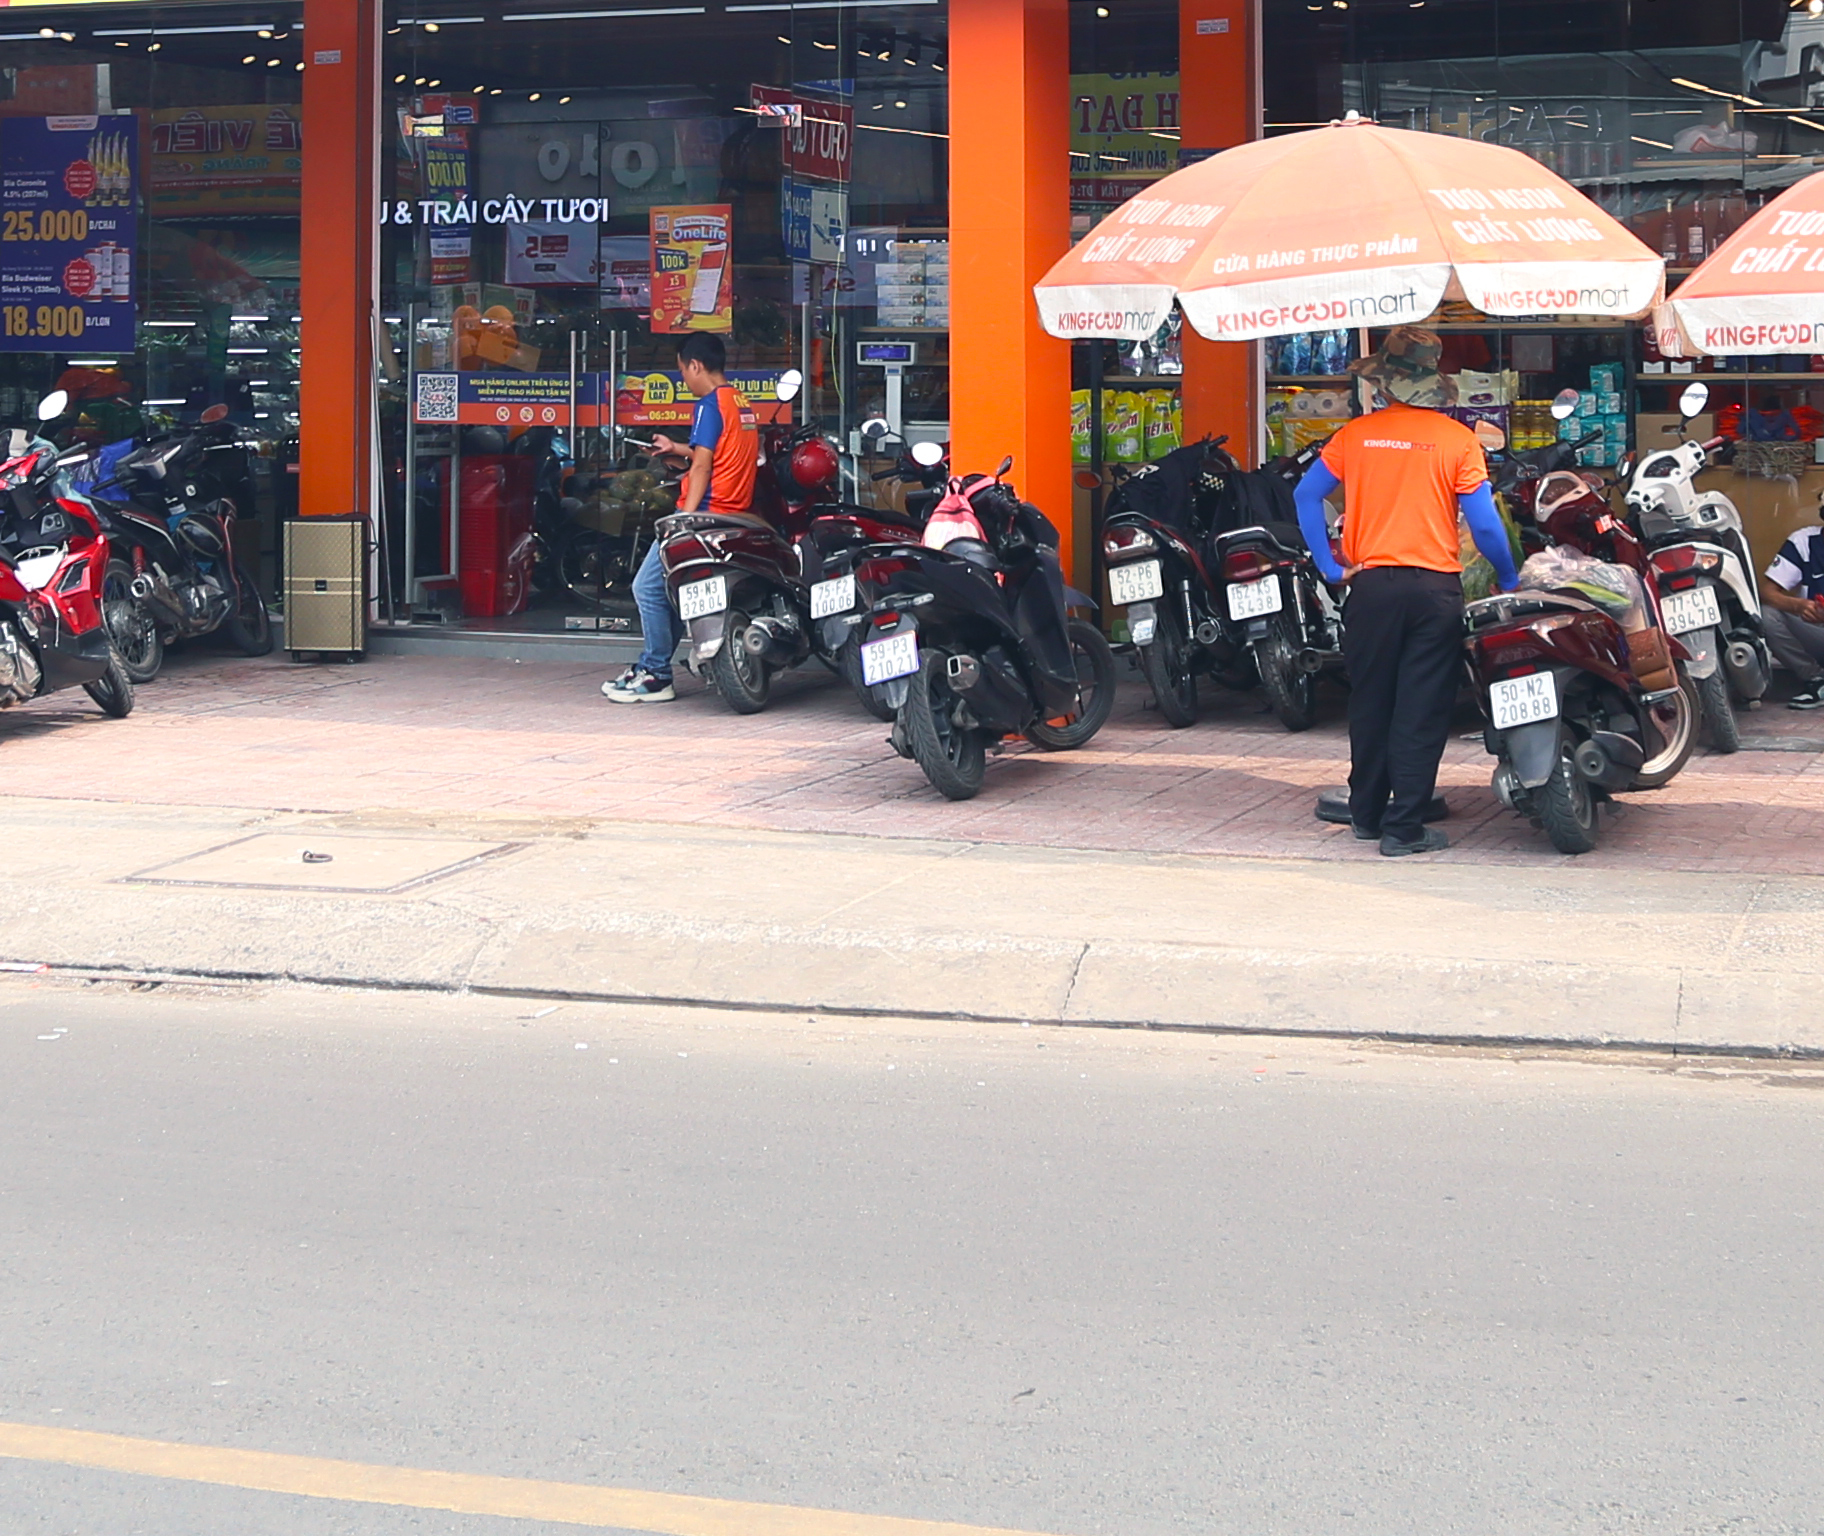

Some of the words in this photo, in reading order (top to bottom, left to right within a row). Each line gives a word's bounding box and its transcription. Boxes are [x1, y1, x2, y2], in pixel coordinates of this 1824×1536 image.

[394, 200, 413, 224] &
[418, 194, 477, 224] TRÁI
[483, 193, 536, 224] CÂY
[541, 198, 609, 223] TƯƠI
[1428, 187, 1494, 211] TƯƠI
[1492, 187, 1567, 211] NGON
[2, 209, 88, 241] 25.000
[1119, 198, 1169, 225] TƯƠI
[1159, 203, 1225, 228] NGON
[672, 226, 727, 242] OneLife
[1452, 213, 1520, 245] CHẤT
[1517, 217, 1605, 248] LƯỢNG
[1081, 228, 1135, 263] CHẤT
[1125, 236, 1196, 266] LƯỢNG
[1213, 246, 1252, 275] CỬA
[1257, 247, 1305, 269] HÀNG
[1311, 241, 1359, 265] THỰC
[1366, 234, 1419, 258] PHẨM
[1731, 239, 1808, 274] CHẤT
[660, 255, 685, 270] 100k
[1216, 287, 1417, 334] KINGFOODmart
[1482, 285, 1630, 311] KINGFOODmart
[2, 305, 84, 337] 18.900
[649, 410, 676, 421] 06:30
[678, 413, 690, 421] AM
[1114, 565, 1152, 585] 52-P6
[686, 580, 718, 601] 59-N3
[818, 579, 848, 601] 75-F2
[1117, 581, 1154, 602] 4953
[1669, 590, 1708, 611] 77-C1
[683, 594, 724, 620] 328.04
[816, 595, 852, 620] 100.06
[1238, 597, 1274, 617] 5438
[1668, 606, 1717, 631] 394.78
[869, 636, 909, 663] 59-P3
[1501, 677, 1545, 704] 50-N2
[1500, 696, 1552, 725] 208.88
